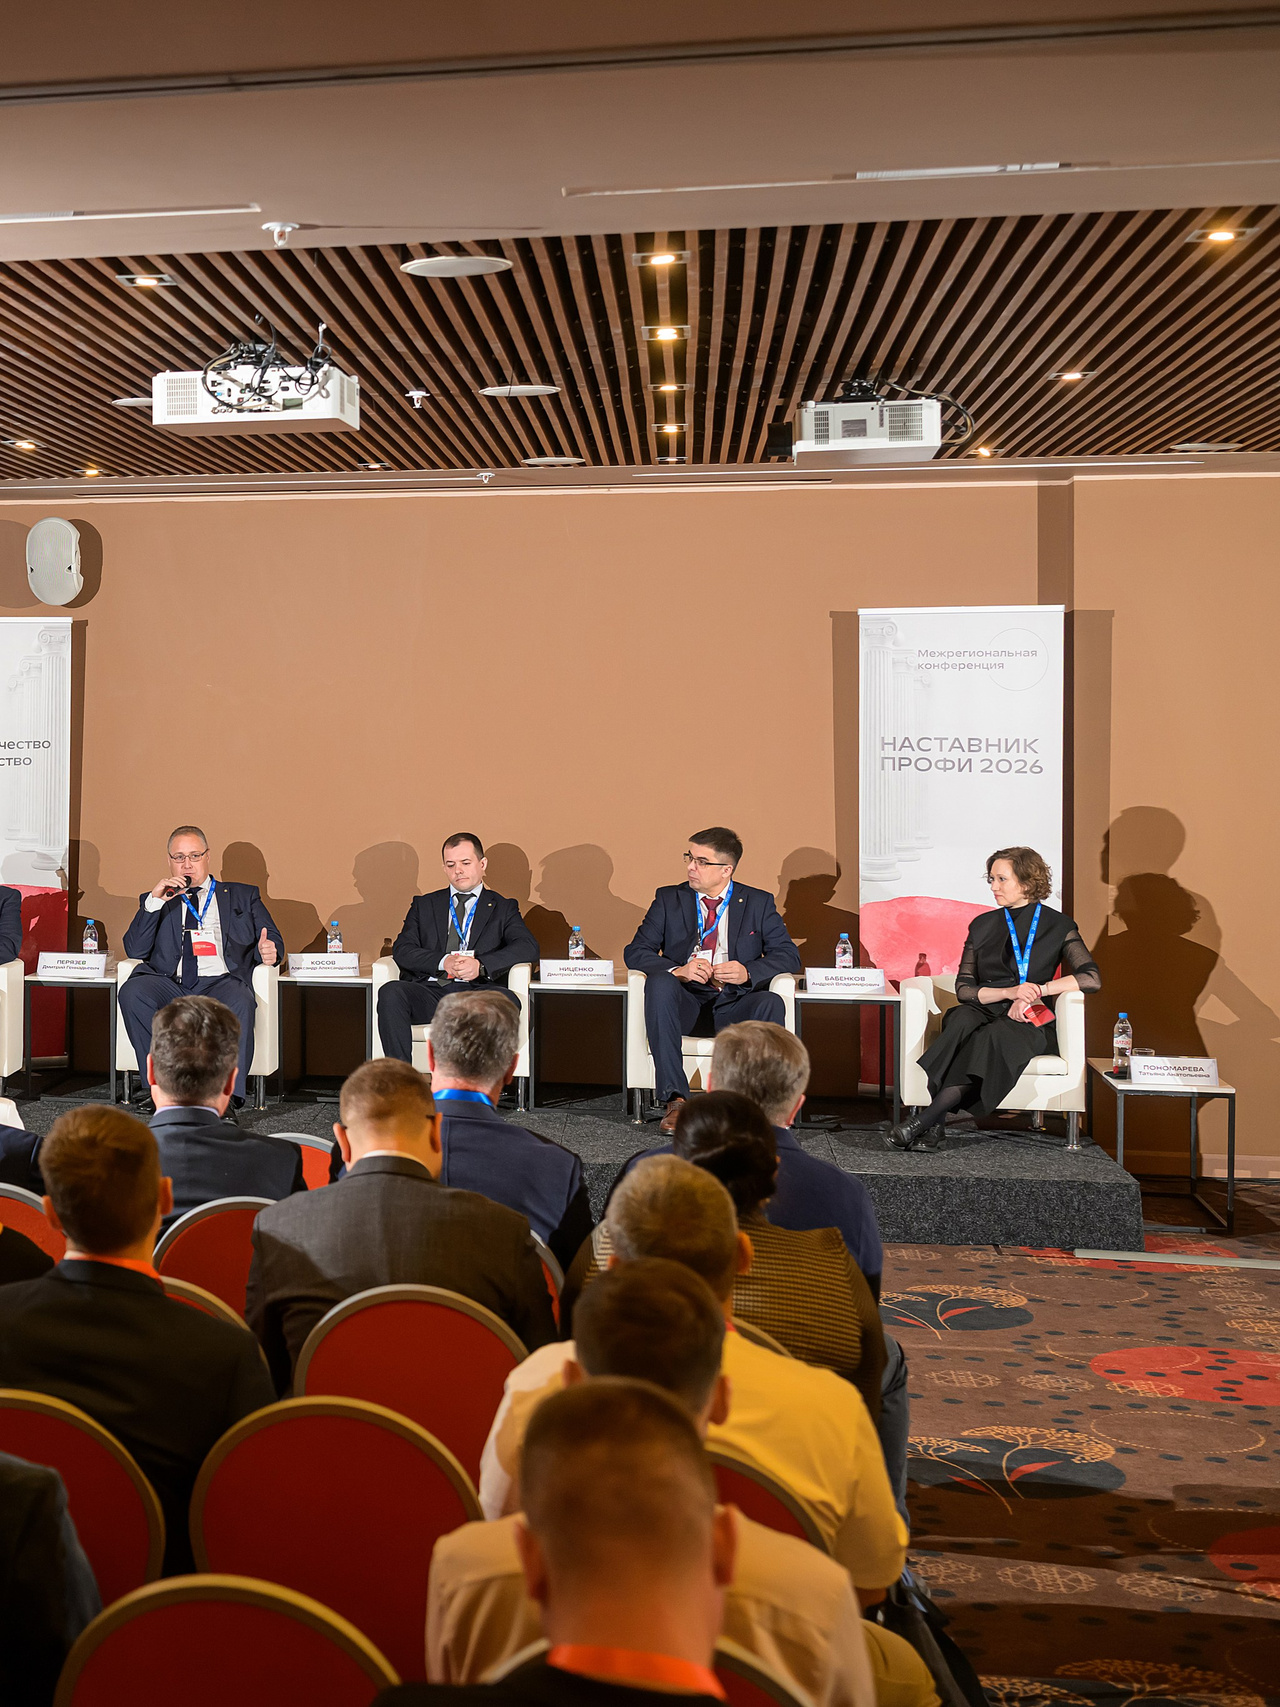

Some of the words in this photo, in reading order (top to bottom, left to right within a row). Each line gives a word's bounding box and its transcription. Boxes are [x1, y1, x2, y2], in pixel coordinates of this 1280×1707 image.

[917, 649, 1038, 659] Межрегиональная
[917, 661, 1005, 671] конференция
[881, 736, 1040, 754] НАСТАВНИК
[881, 756, 973, 773] ПРОФИ
[980, 758, 1044, 775] 2026
[1143, 1064, 1205, 1072] ПОНОМАРЕВА
